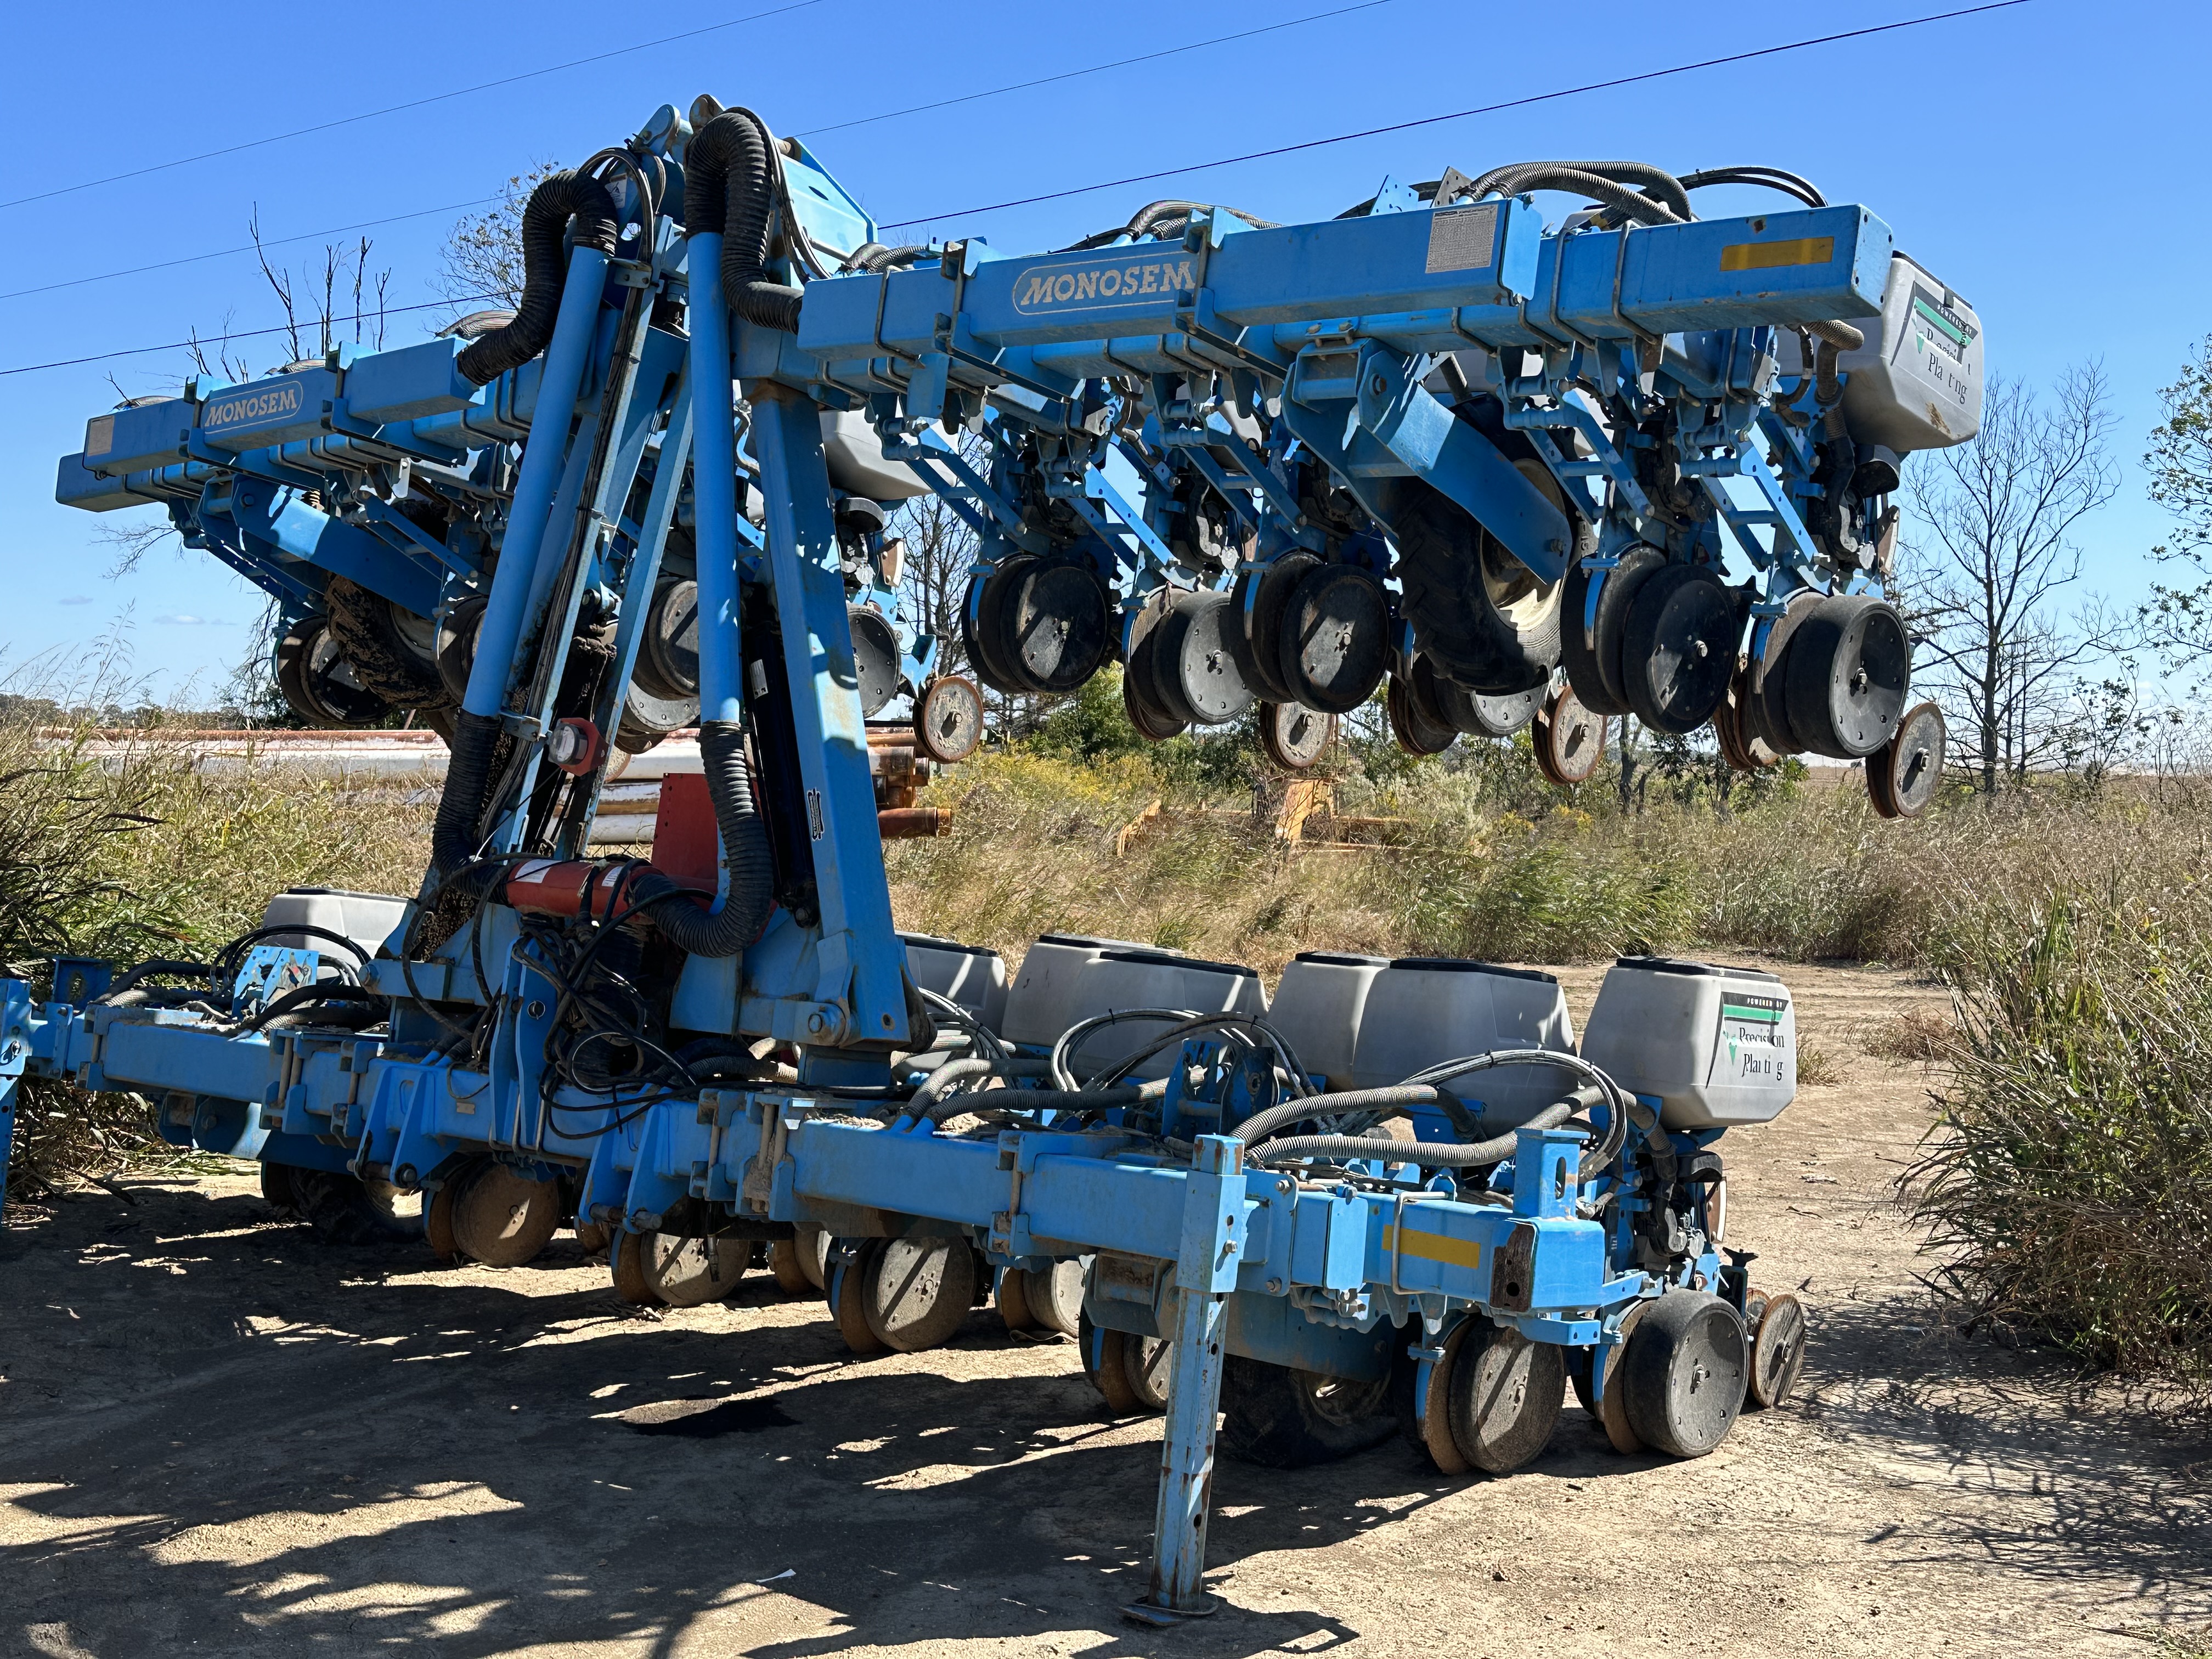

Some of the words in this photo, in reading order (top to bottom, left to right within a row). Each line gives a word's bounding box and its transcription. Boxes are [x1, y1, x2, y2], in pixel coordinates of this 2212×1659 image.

[1020, 261, 1196, 306] MONOSEM
[1927, 352, 1968, 405] Platng
[204, 389, 297, 427] MONOSEM
[1741, 1053, 1784, 1081] Platig
